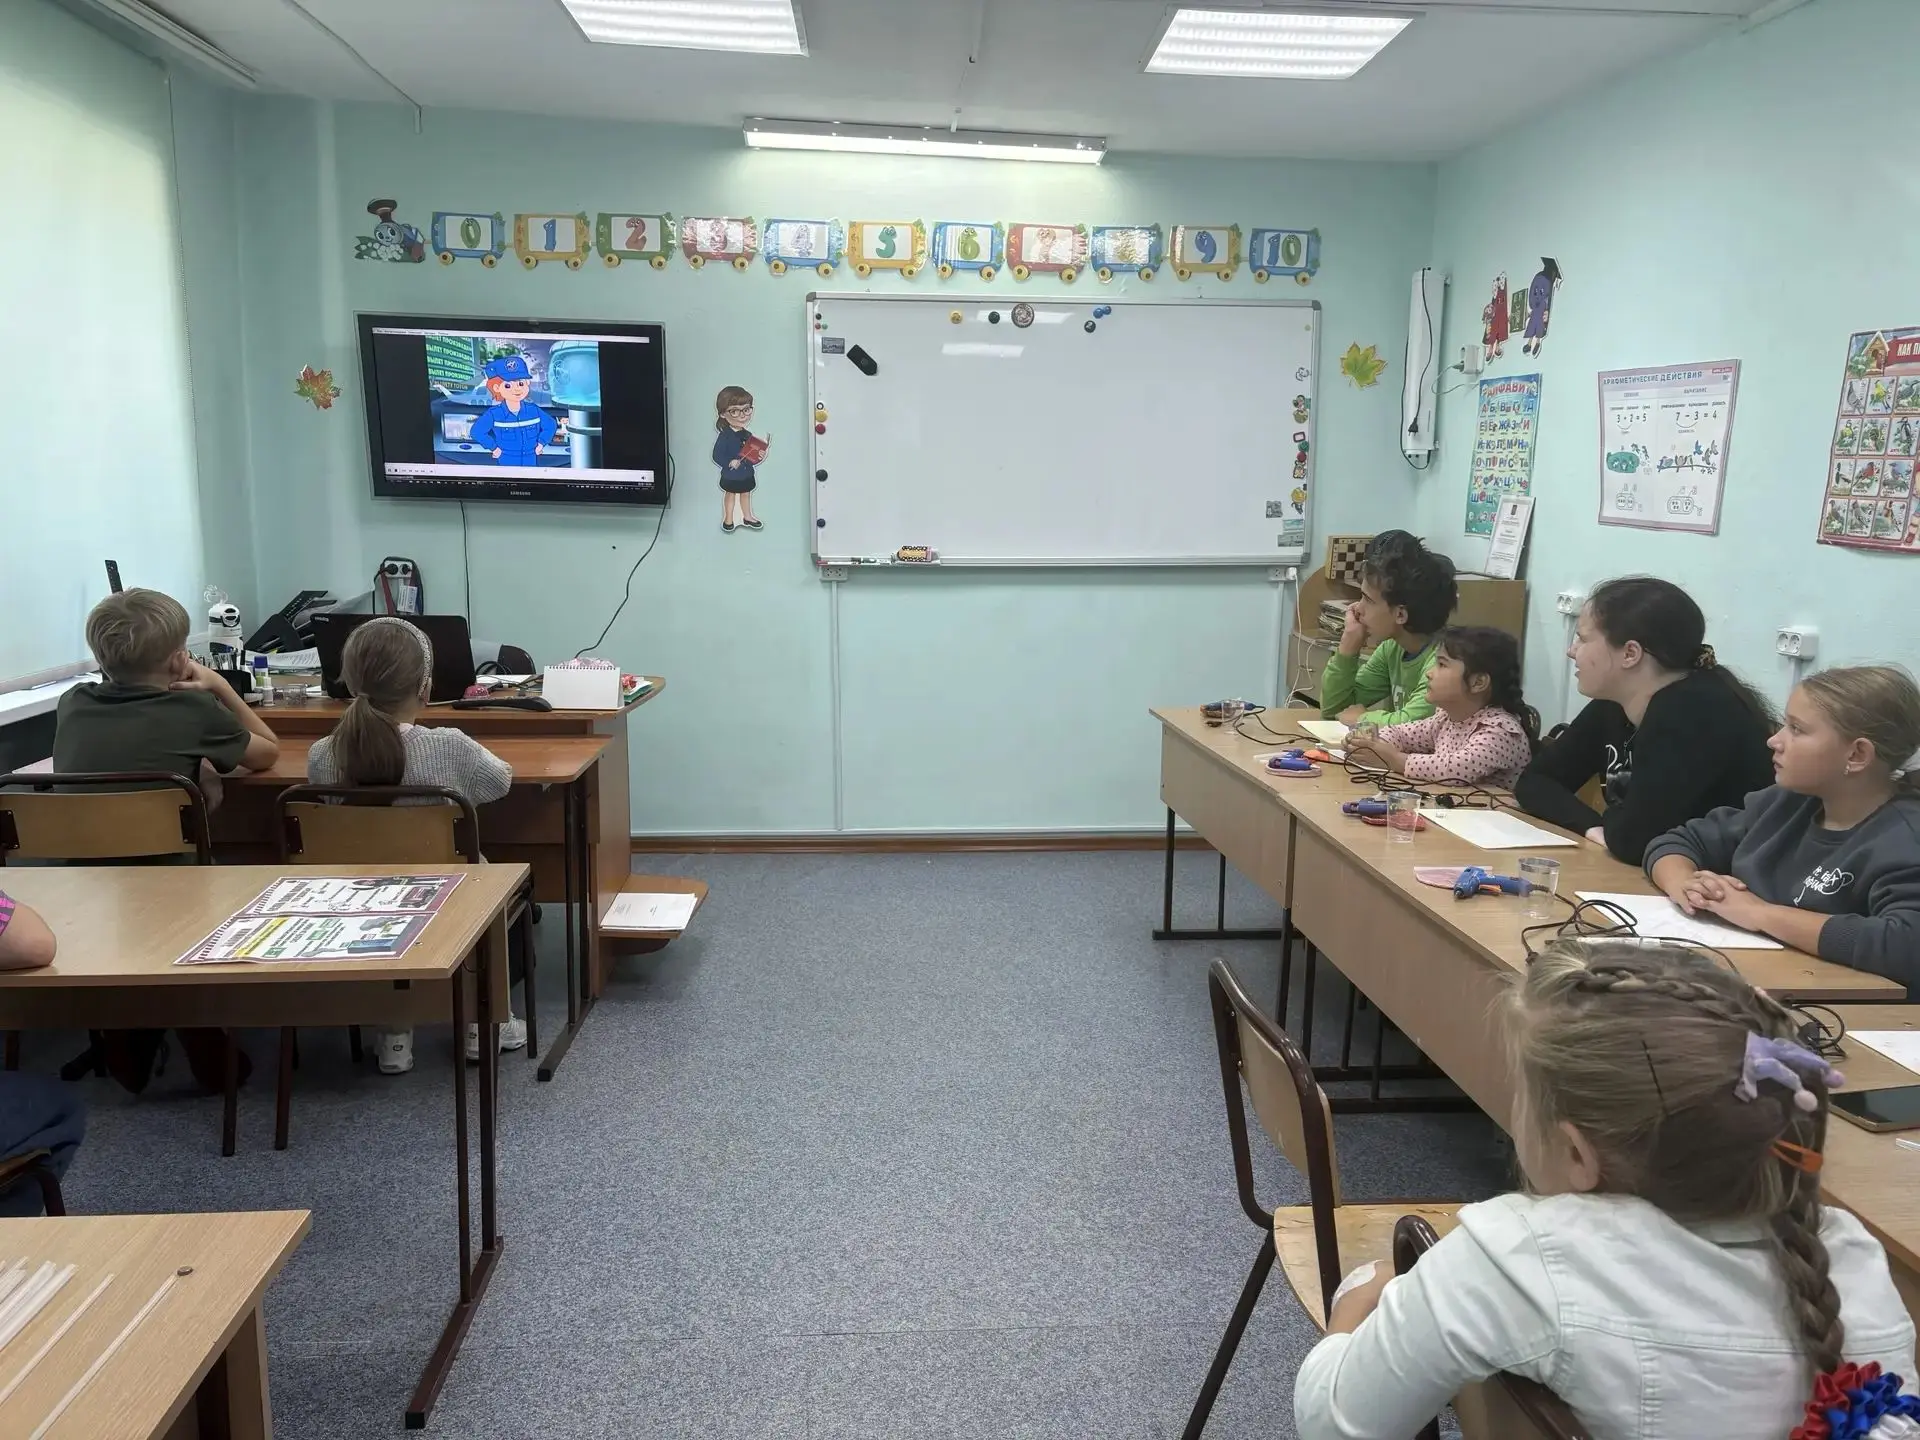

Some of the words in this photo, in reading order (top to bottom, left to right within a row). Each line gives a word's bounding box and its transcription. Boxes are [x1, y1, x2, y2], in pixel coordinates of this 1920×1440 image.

[460, 217, 482, 249] 0
[543, 218, 556, 252] 1
[625, 216, 648, 251] 2
[876, 226, 898, 258] 5
[958, 226, 980, 260] 6
[1194, 230, 1217, 264] 9
[1266, 232, 1302, 266] 10
[1603, 374, 1658, 385] АРИФМЕТИЧЕСКИЕ
[1660, 370, 1702, 382] ДЕЙСТВИЯ
